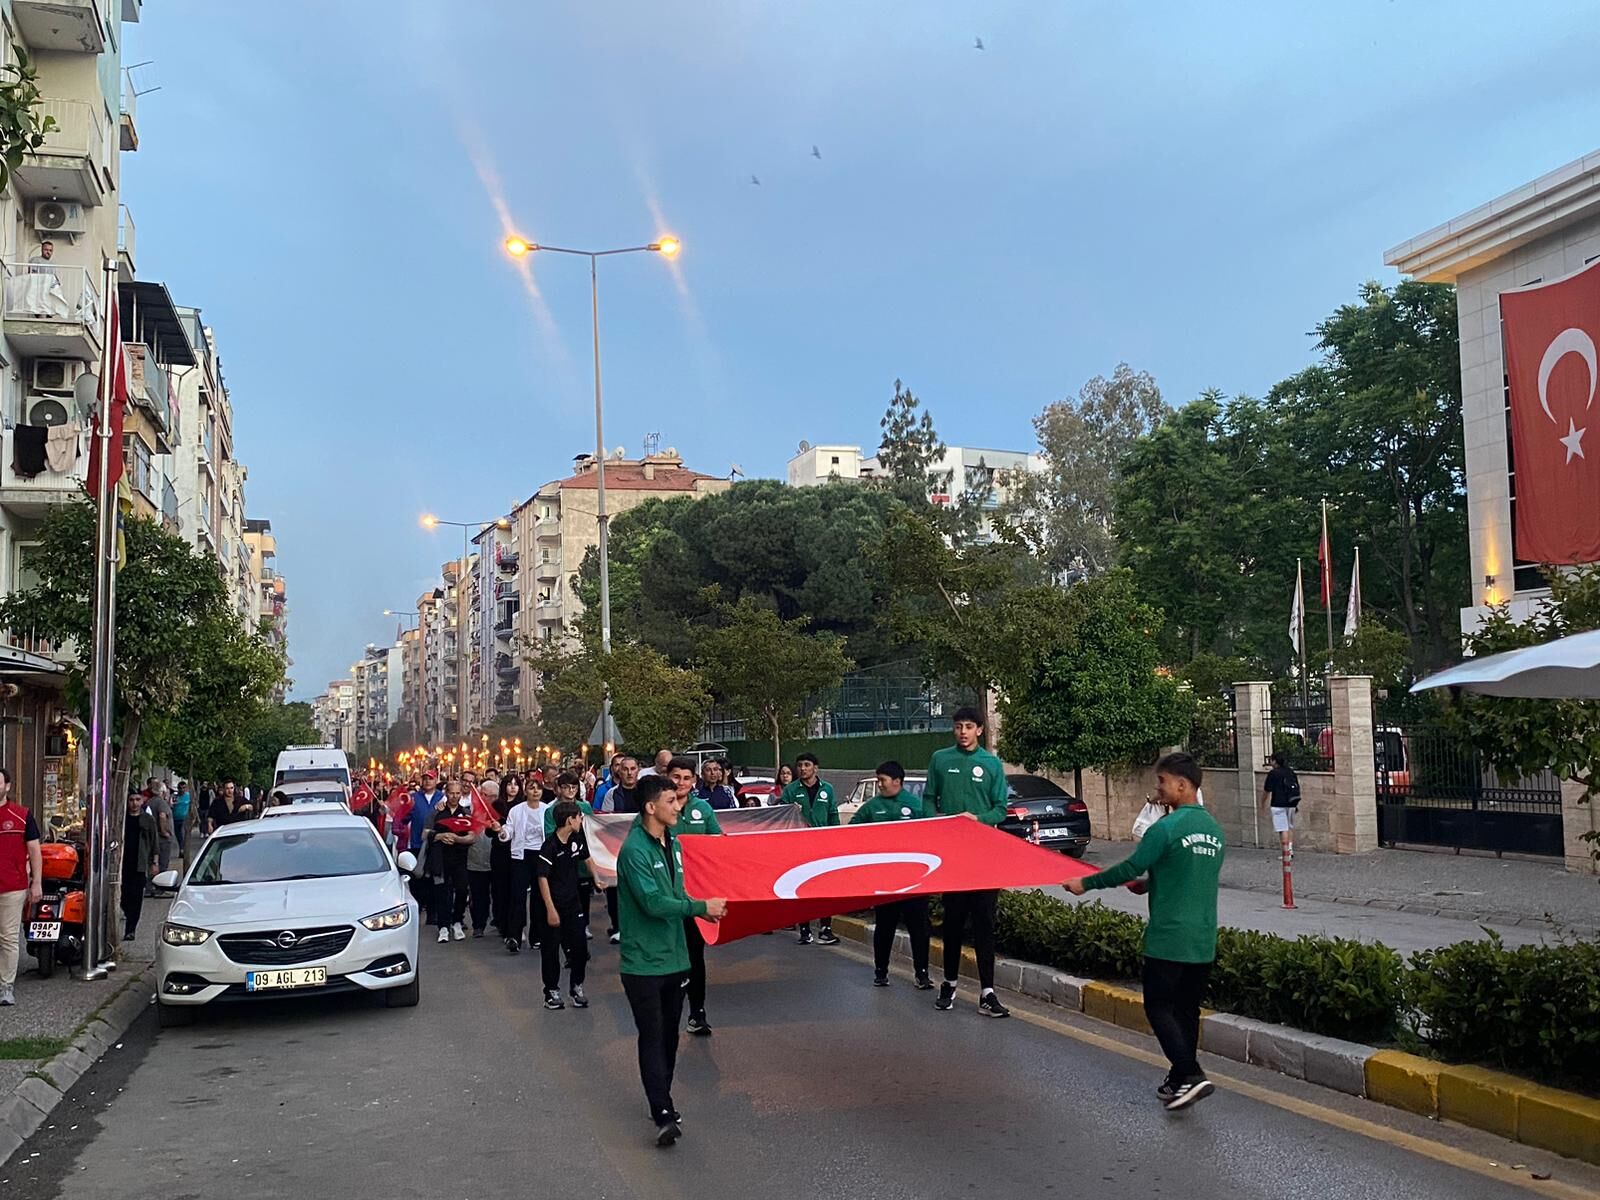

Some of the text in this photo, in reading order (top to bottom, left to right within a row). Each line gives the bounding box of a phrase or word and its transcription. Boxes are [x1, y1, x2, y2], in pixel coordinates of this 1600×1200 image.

[255, 974, 269, 986] 09
[276, 972, 297, 984] AGL
[304, 969, 325, 983] 213
